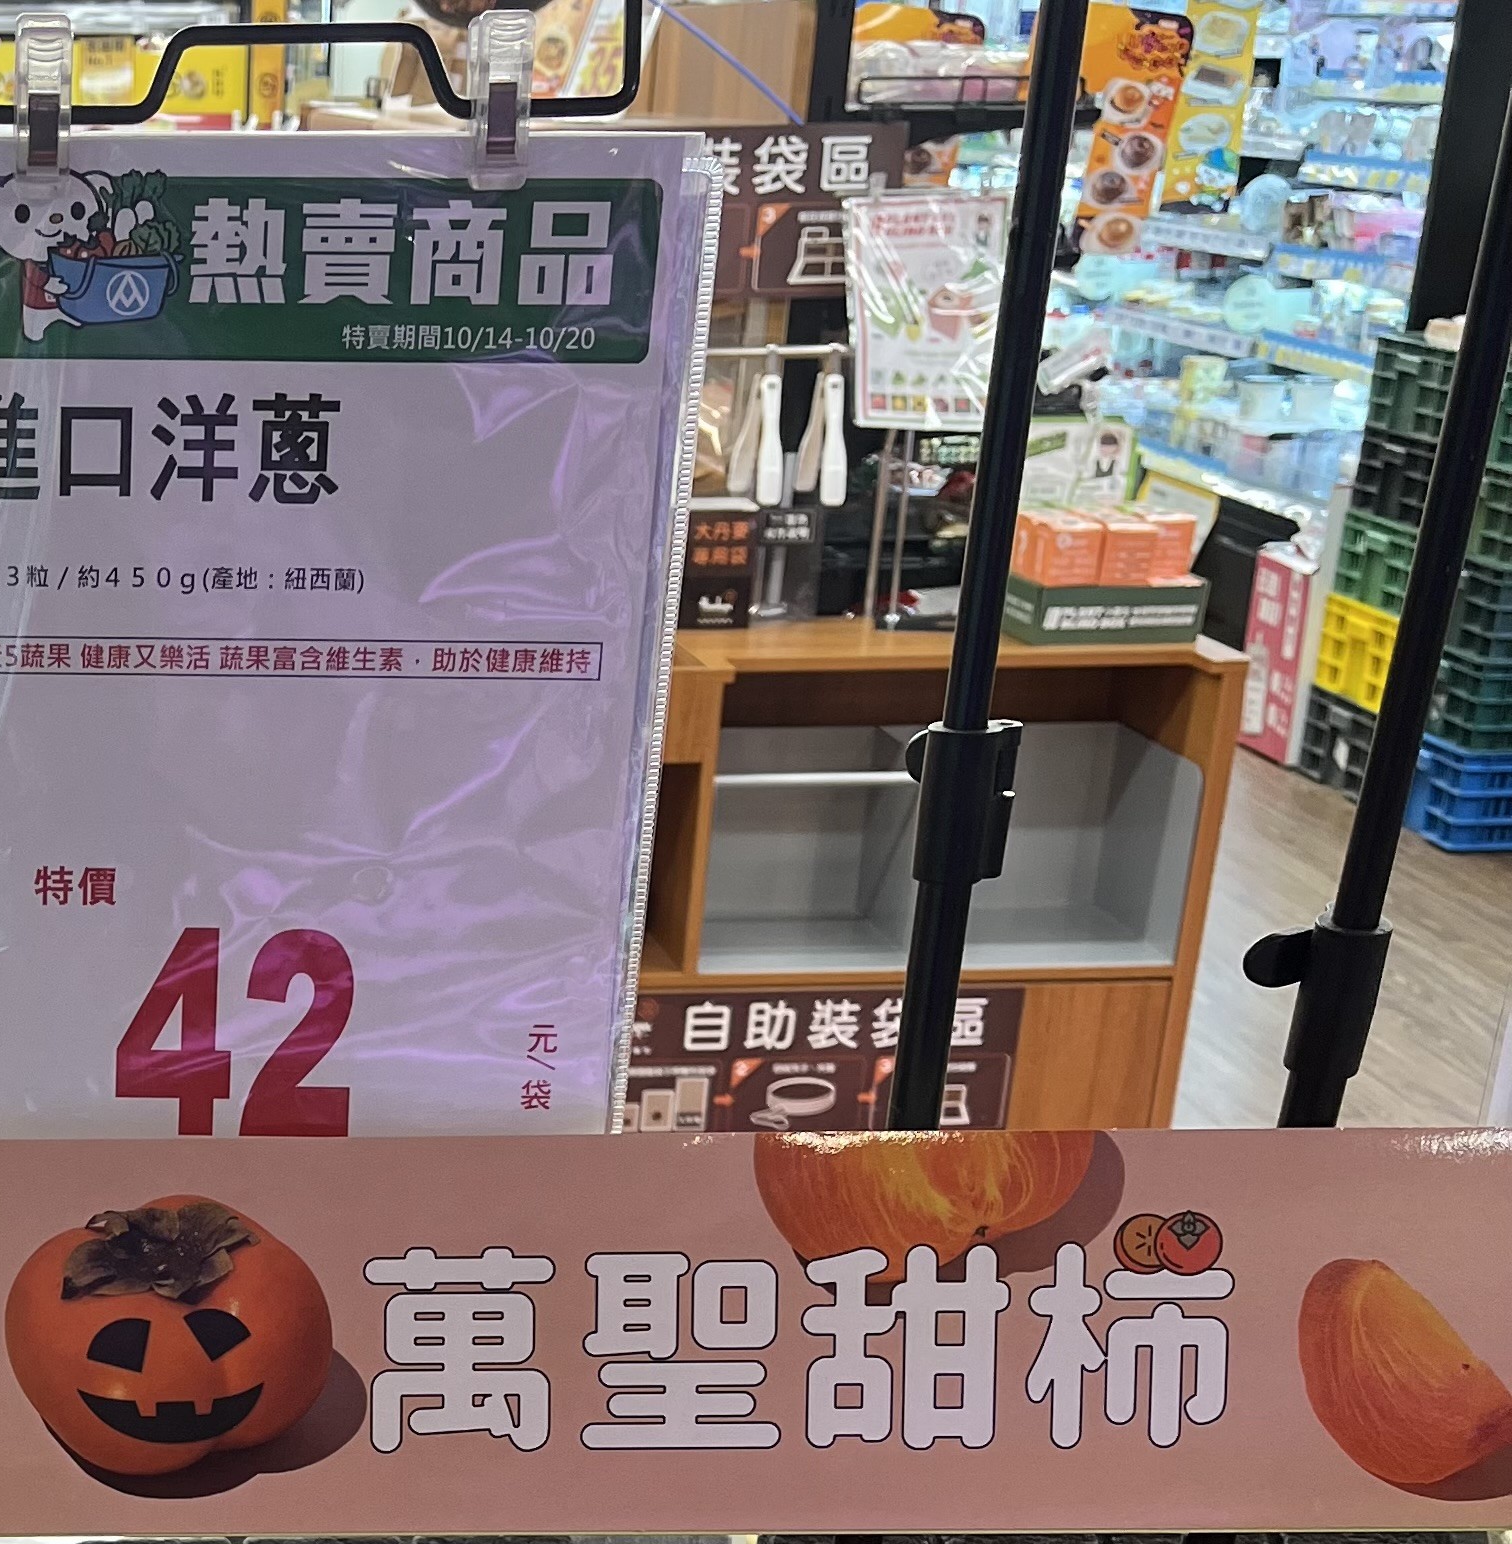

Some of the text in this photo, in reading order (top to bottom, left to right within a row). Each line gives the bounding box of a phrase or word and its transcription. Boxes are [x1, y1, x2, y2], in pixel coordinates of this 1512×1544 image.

[188, 196, 615, 307] 熱賣商品
[341, 324, 596, 353] 特賣期間10/14-10/20
[80, 642, 212, 672] 健康又樂活
[32, 865, 118, 907] 特價
[114, 926, 356, 1139] 42
[519, 1023, 559, 1111] 元/袋
[362, 1242, 1236, 1454] 萬聖甜柿
